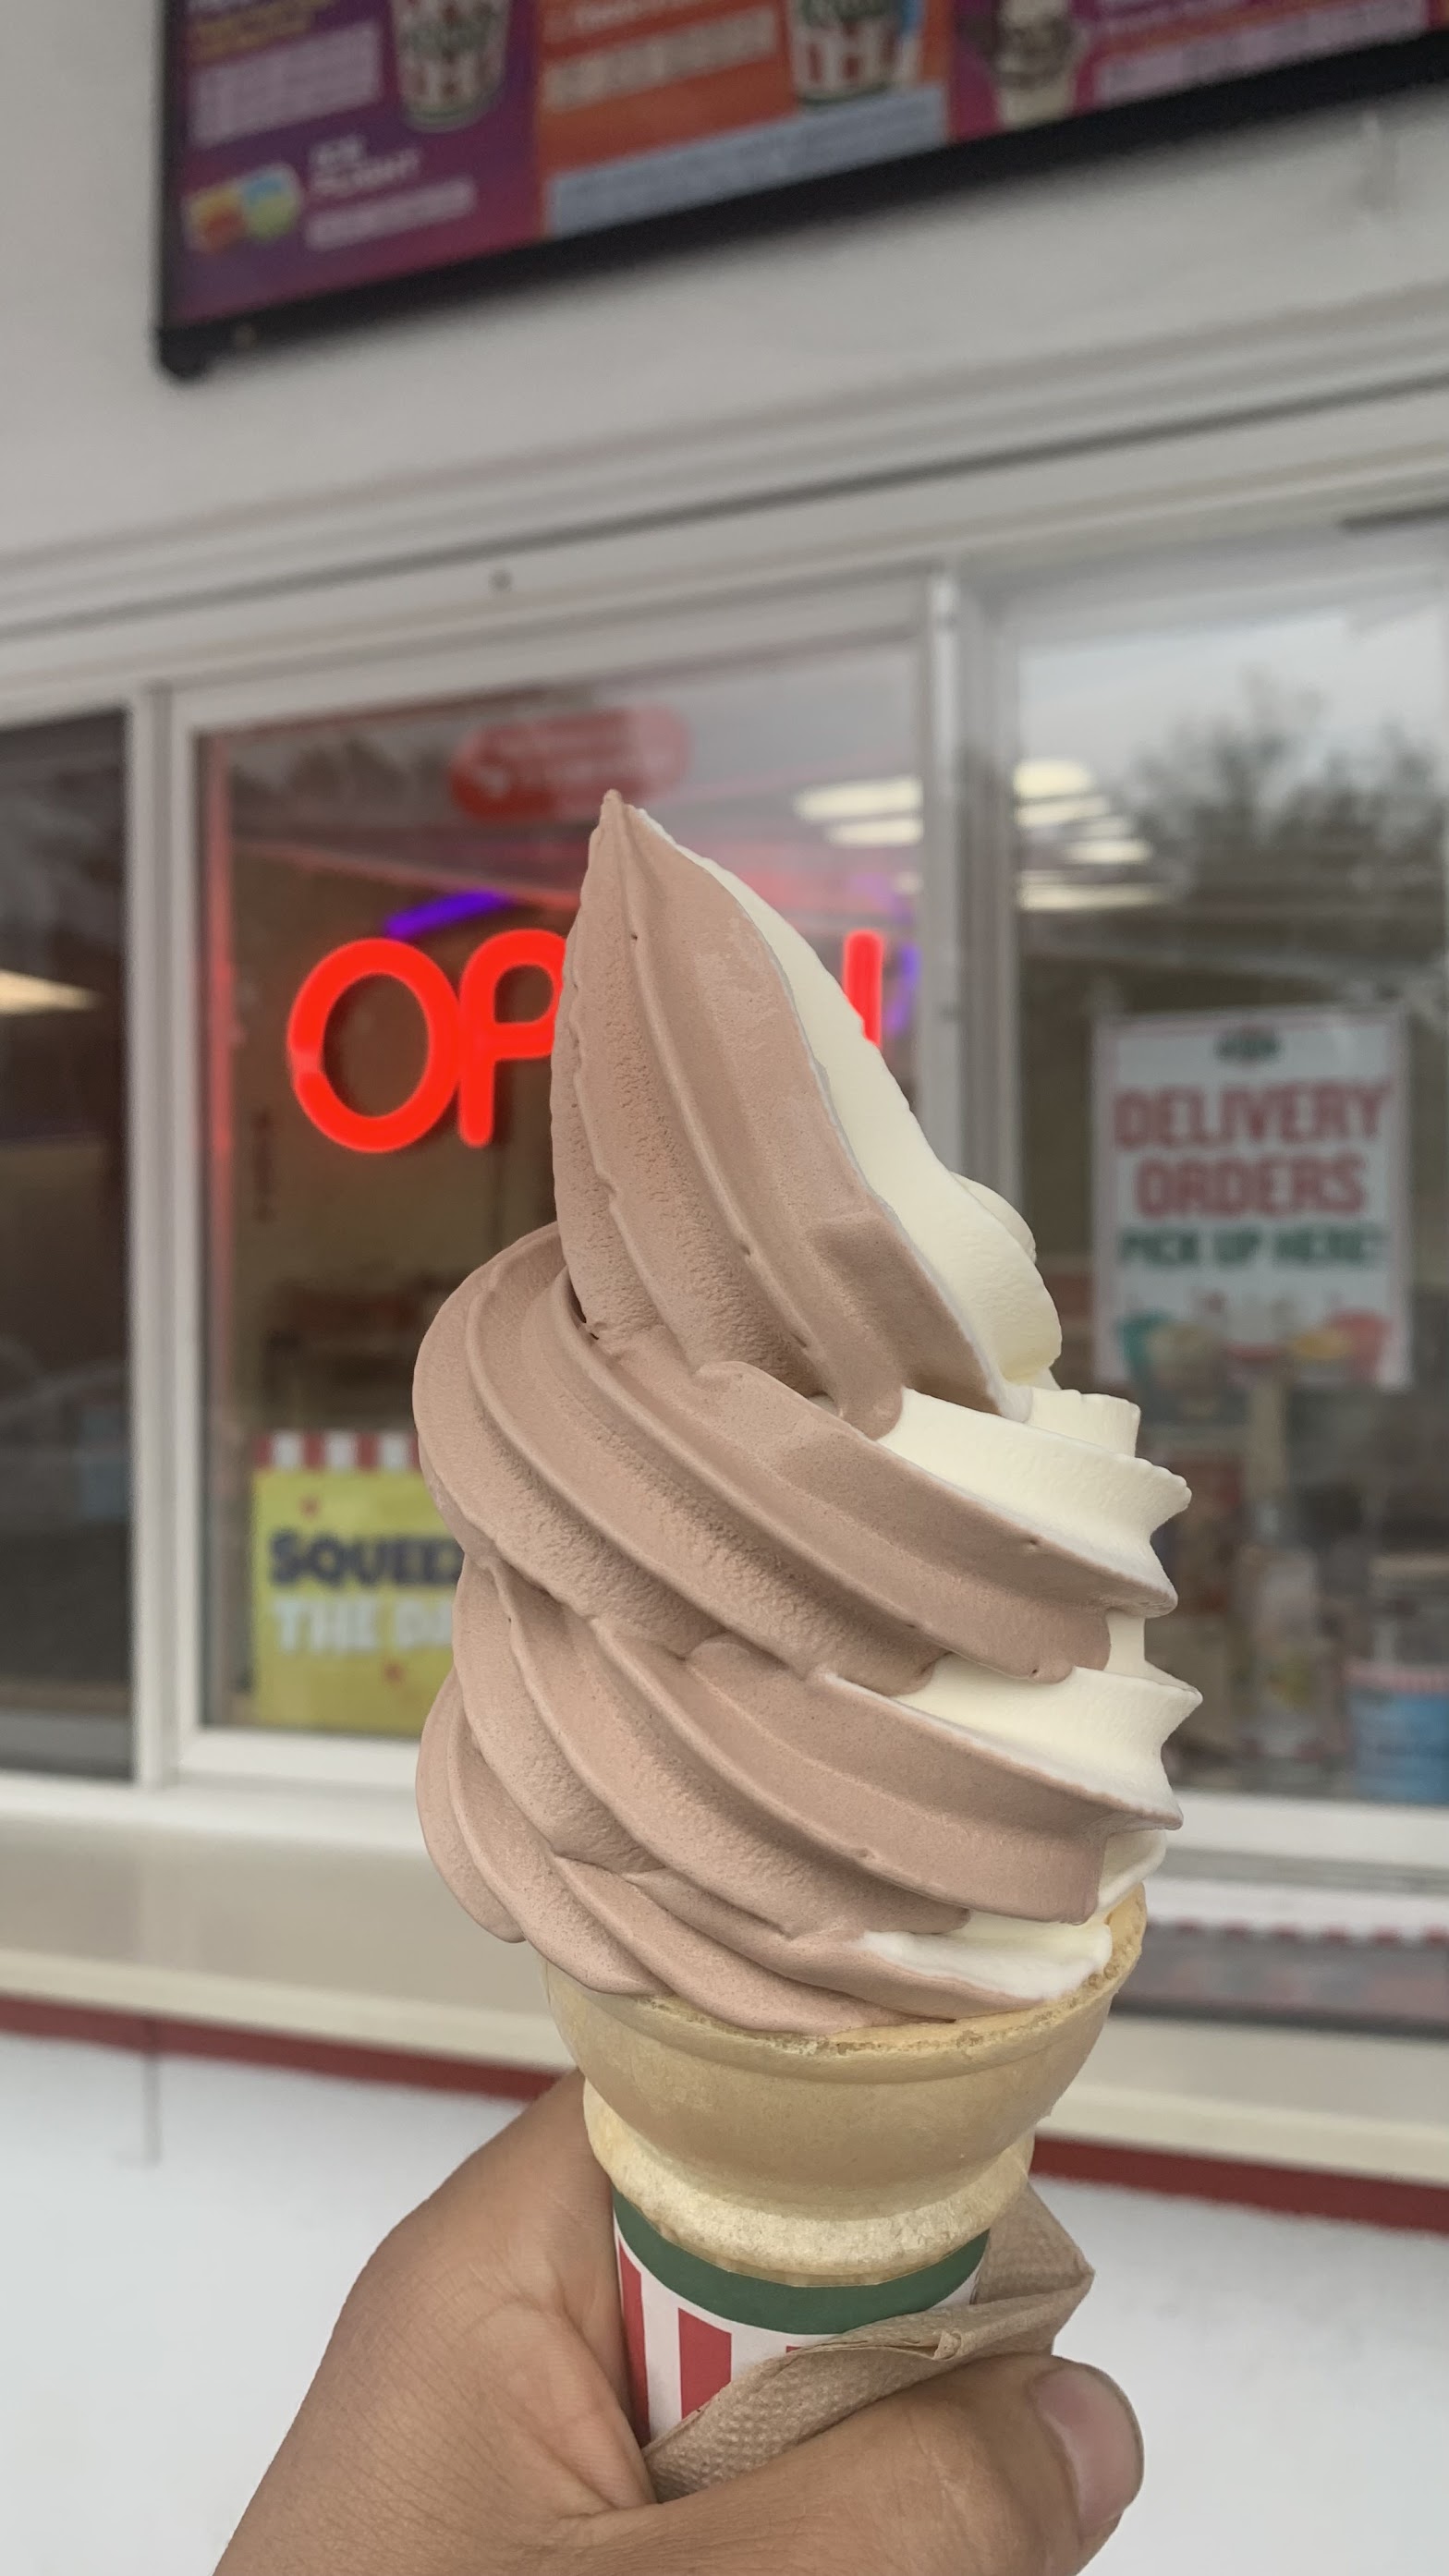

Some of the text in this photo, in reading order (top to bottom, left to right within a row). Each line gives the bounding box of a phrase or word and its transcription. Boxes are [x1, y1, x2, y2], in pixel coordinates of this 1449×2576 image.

[1114, 1079, 1389, 1151] DELIVERY
[1135, 1151, 1366, 1220] ORDERS
[1212, 1227, 1262, 1268] UP
[269, 1528, 465, 1588] SQUEE
[269, 1595, 378, 1653] THE
